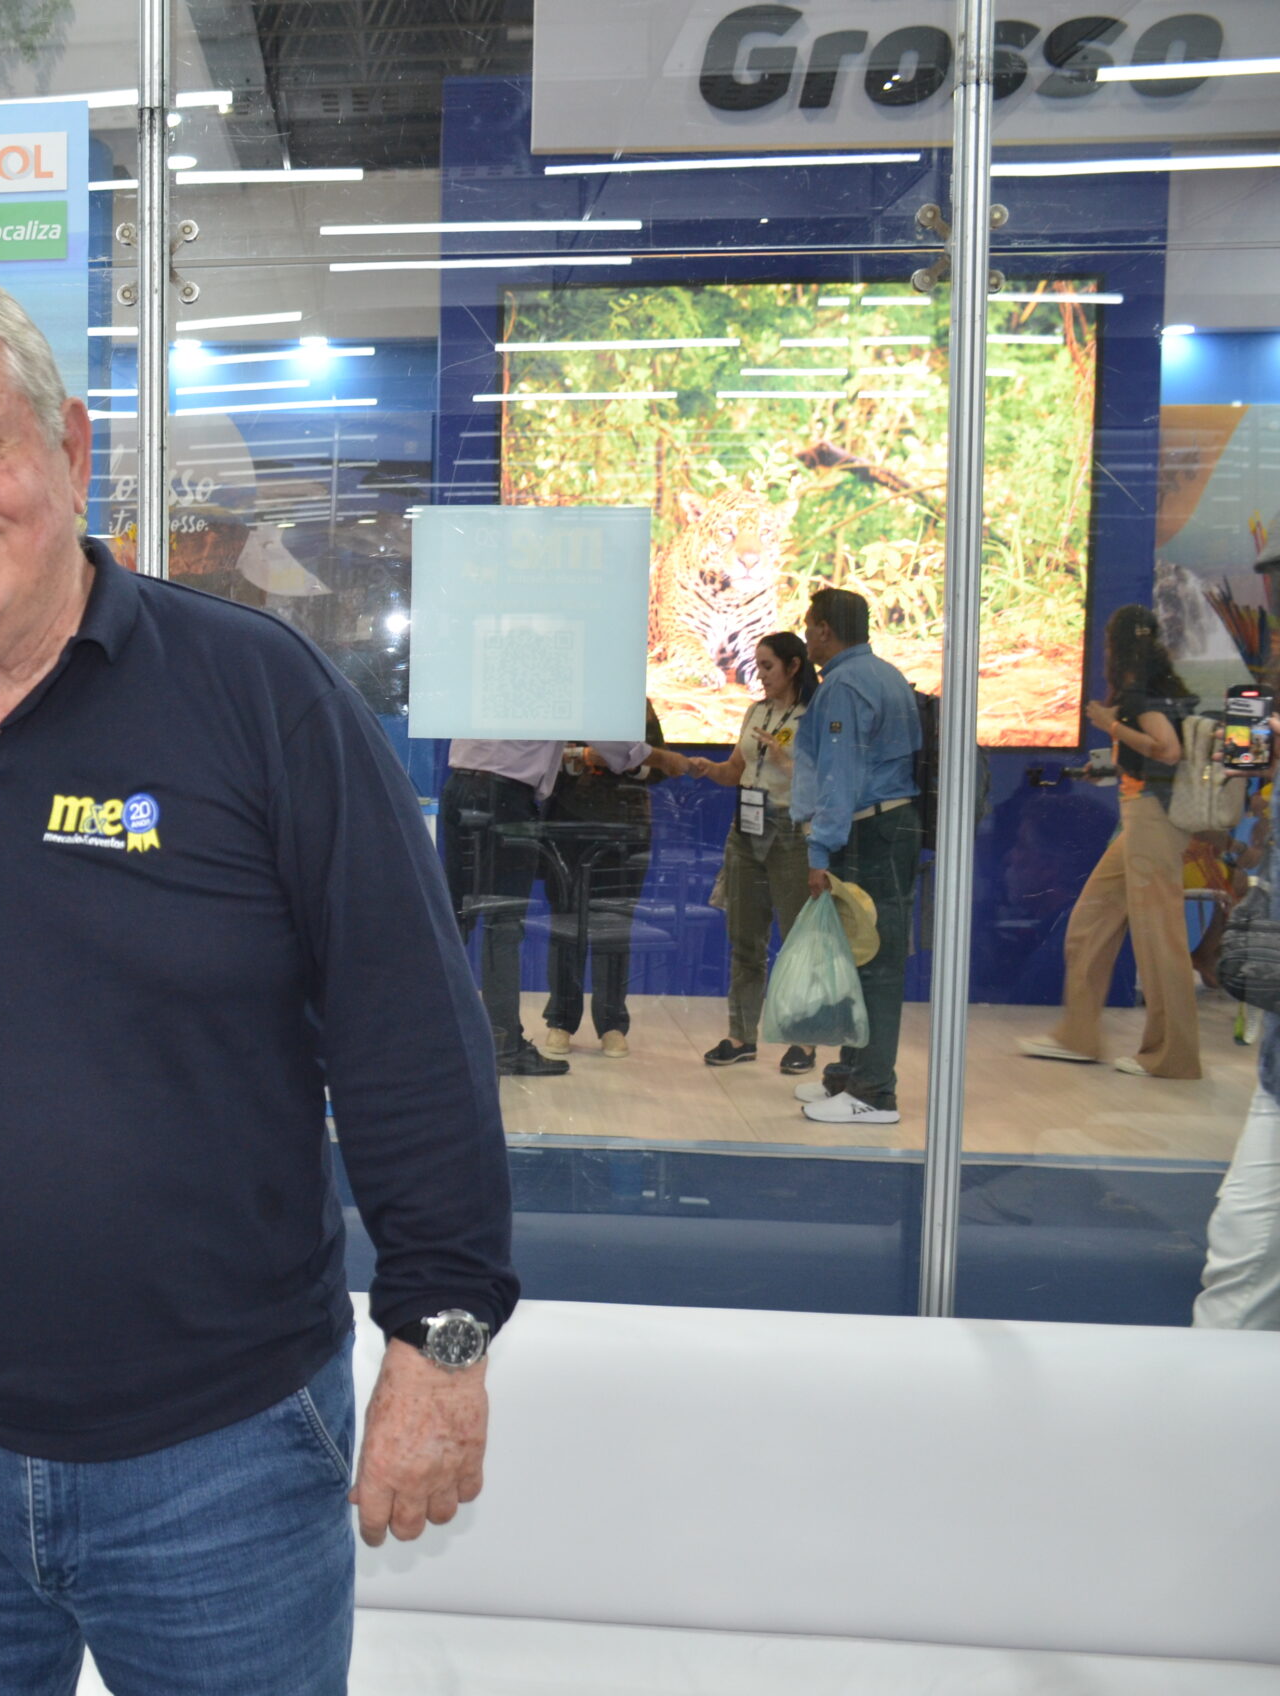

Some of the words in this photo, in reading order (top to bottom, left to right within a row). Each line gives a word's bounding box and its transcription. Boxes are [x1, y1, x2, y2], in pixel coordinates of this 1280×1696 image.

[699, 4, 1224, 111] Grosso
[47, 794, 124, 836] m&e
[130, 801, 151, 820] 20
